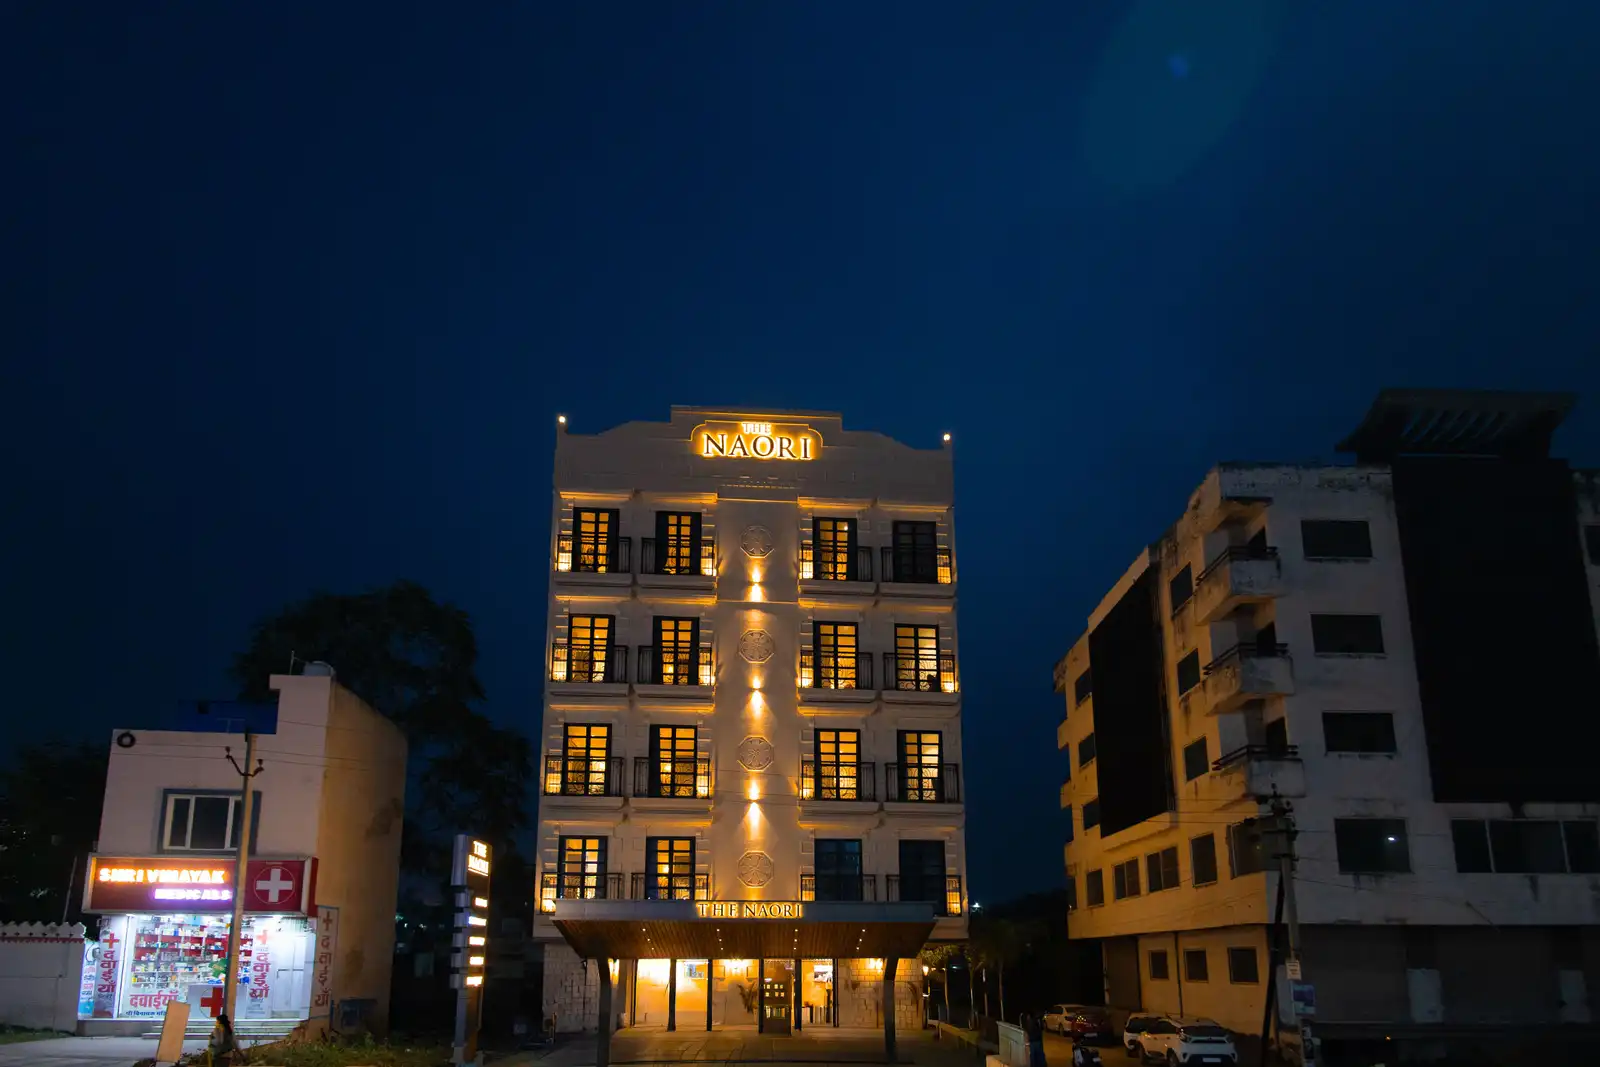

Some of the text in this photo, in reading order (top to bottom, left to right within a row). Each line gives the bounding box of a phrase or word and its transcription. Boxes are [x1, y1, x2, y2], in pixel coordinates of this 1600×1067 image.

[742, 422, 772, 434] THE
[703, 433, 811, 459] NAORI
[99, 868, 225, 883] SHRI VINAYAK
[697, 903, 802, 917] THE NAORI
